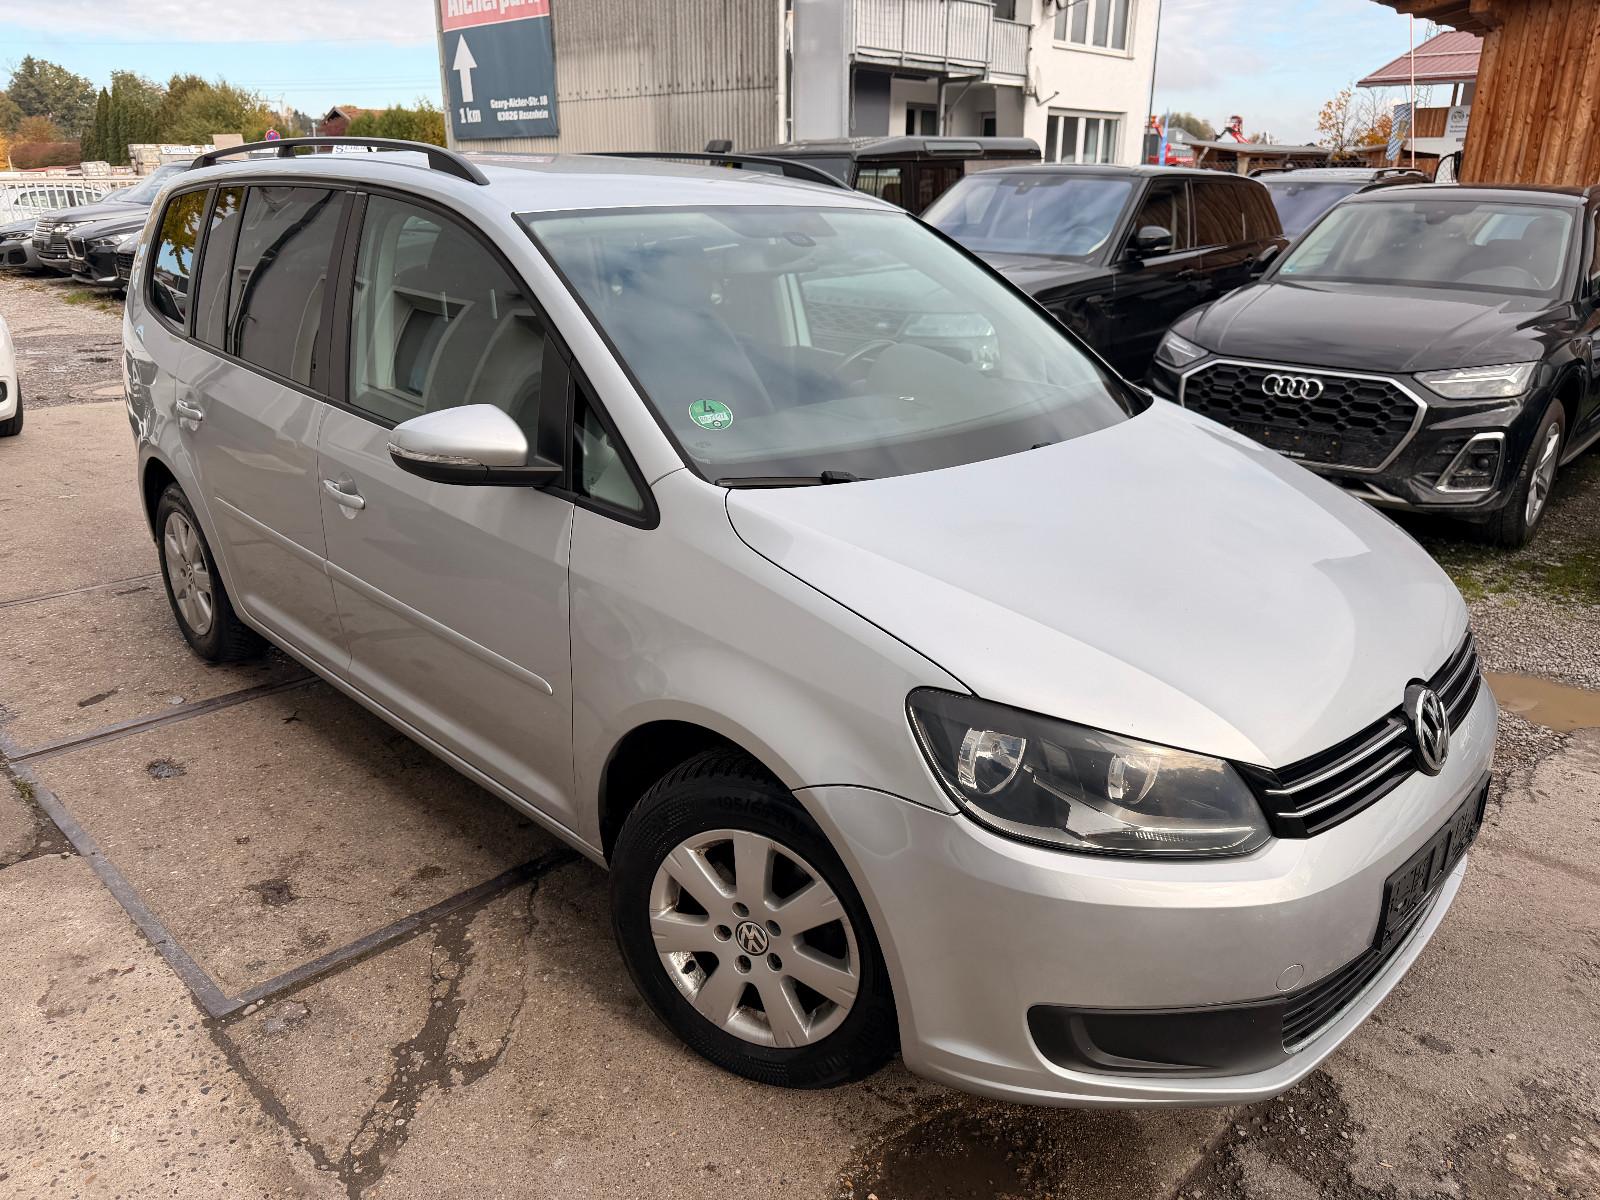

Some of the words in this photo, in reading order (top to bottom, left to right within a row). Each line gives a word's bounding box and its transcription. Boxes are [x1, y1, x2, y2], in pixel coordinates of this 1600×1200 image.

[447, 0, 540, 18] Aicherp
[459, 108, 466, 123] 1
[466, 107, 481, 122] km
[519, 109, 549, 120] Rosenheim
[703, 400, 715, 413] 4
